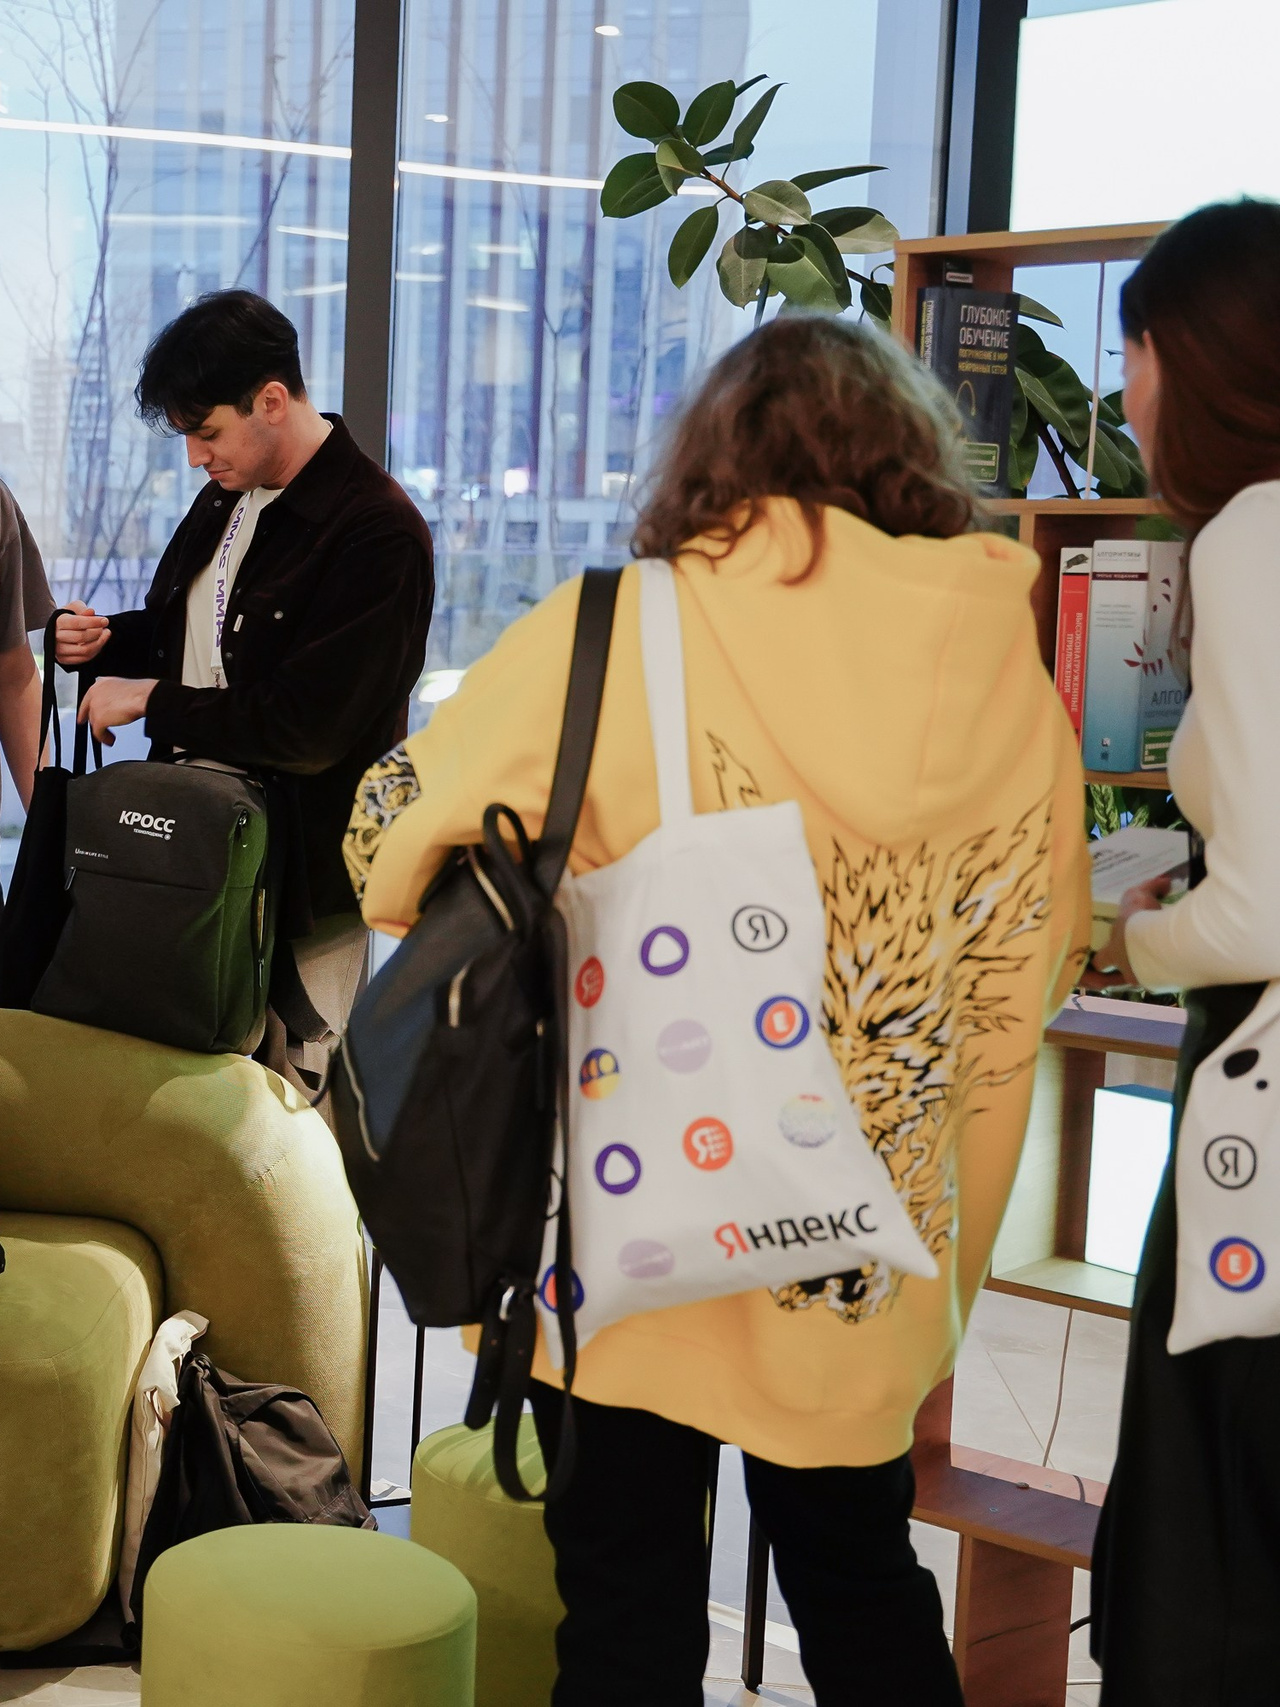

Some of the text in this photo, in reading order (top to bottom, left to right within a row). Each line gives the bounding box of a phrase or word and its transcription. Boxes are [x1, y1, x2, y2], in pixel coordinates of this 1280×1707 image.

[960, 304, 1012, 327] ГЛУБОКОЕ
[959, 327, 1010, 349] ОБУЧЕНИЕ
[1151, 690, 1185, 705] АЛГО
[119, 810, 176, 833] КРОСС
[714, 1203, 878, 1261] Яндекс
